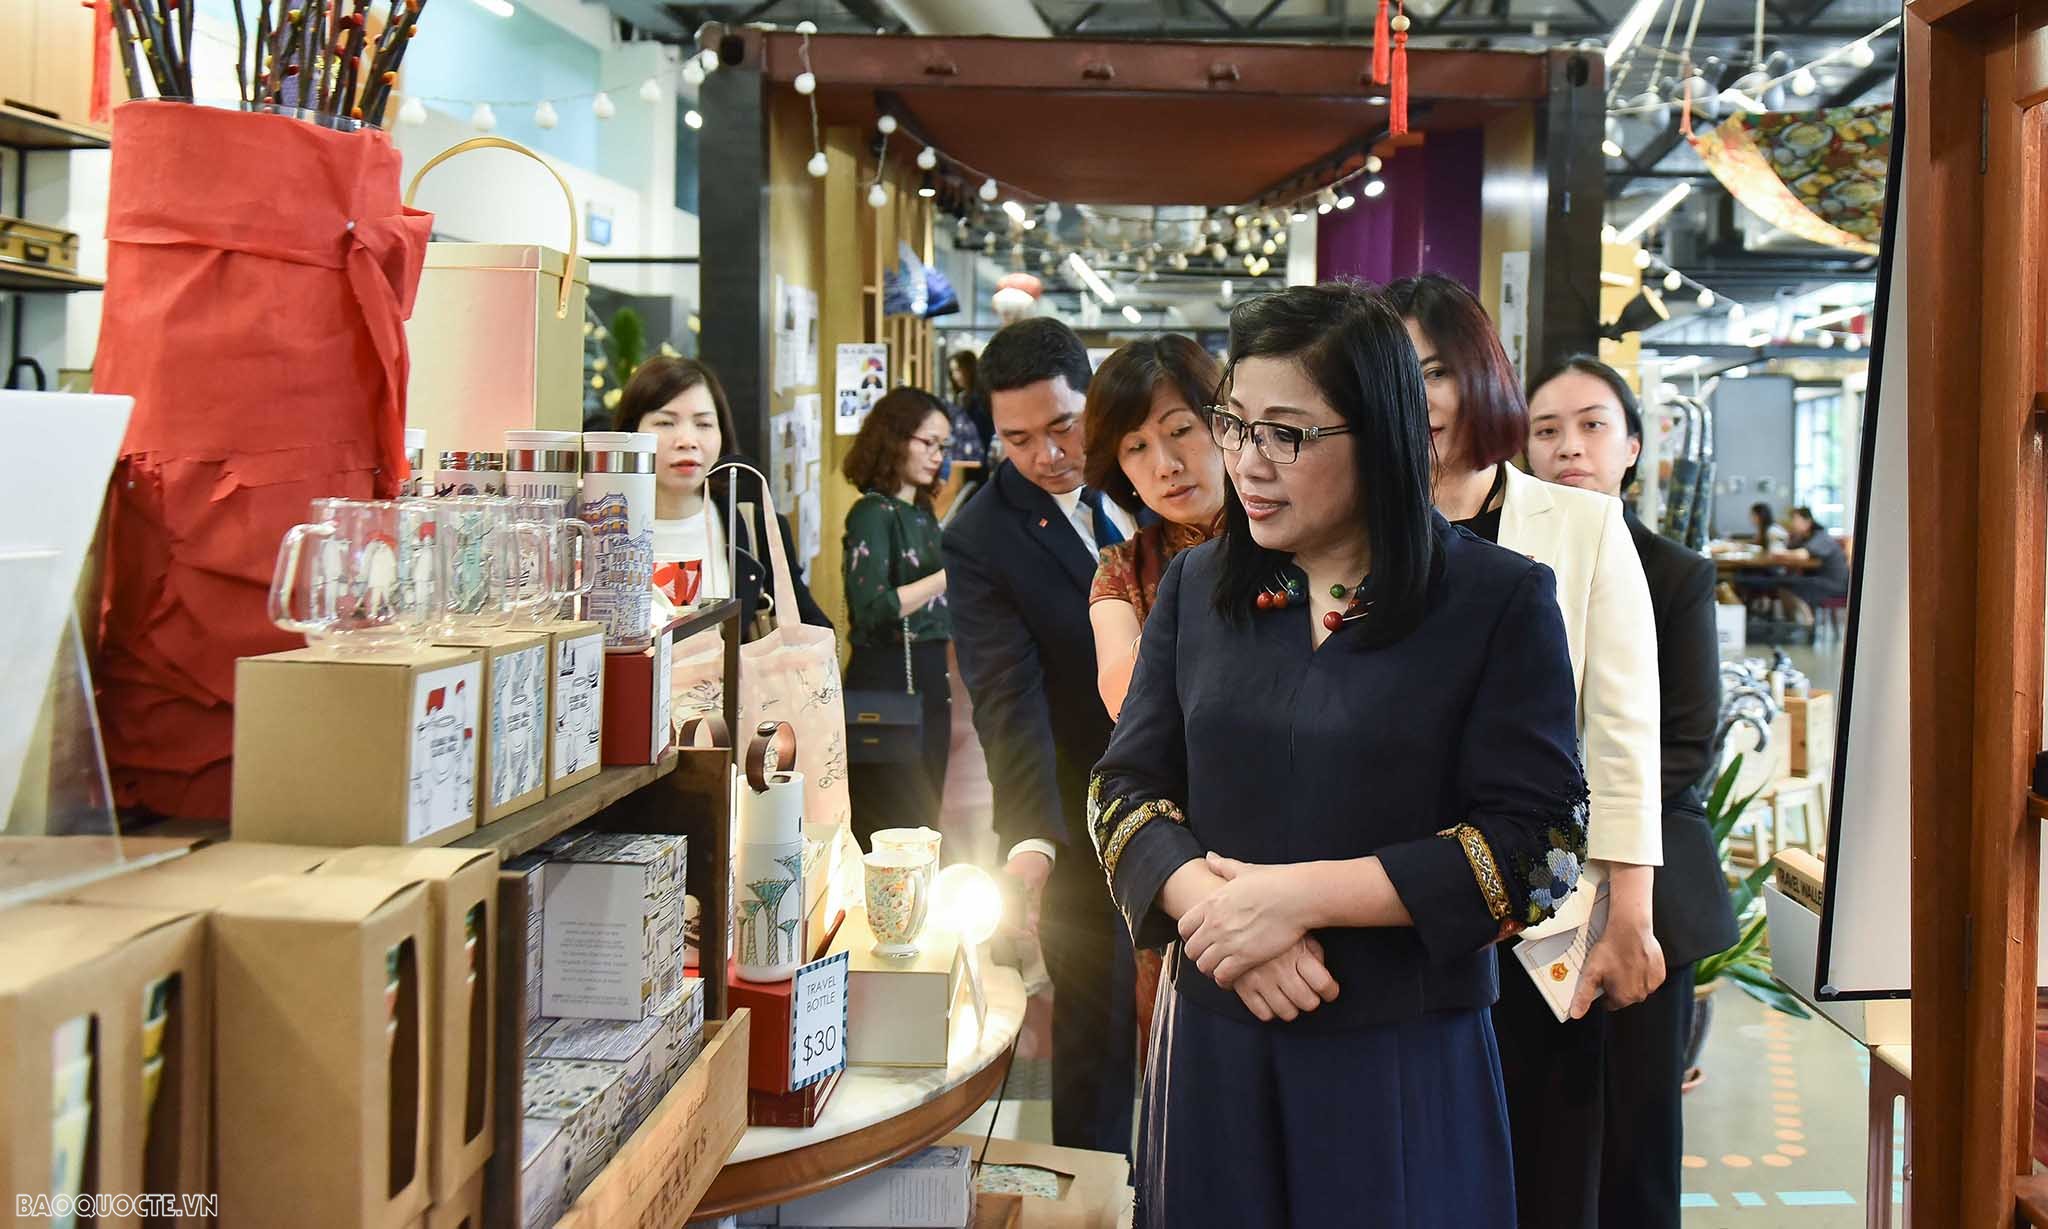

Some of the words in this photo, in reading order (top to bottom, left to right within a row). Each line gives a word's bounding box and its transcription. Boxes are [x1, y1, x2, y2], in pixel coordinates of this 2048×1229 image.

[1777, 867, 1801, 893] TRAVEL
[1799, 879, 1823, 906] WALLE
[806, 975, 837, 997] TRAVEL
[806, 991, 836, 1013] BOTTLE
[802, 1024, 837, 1066] $30
